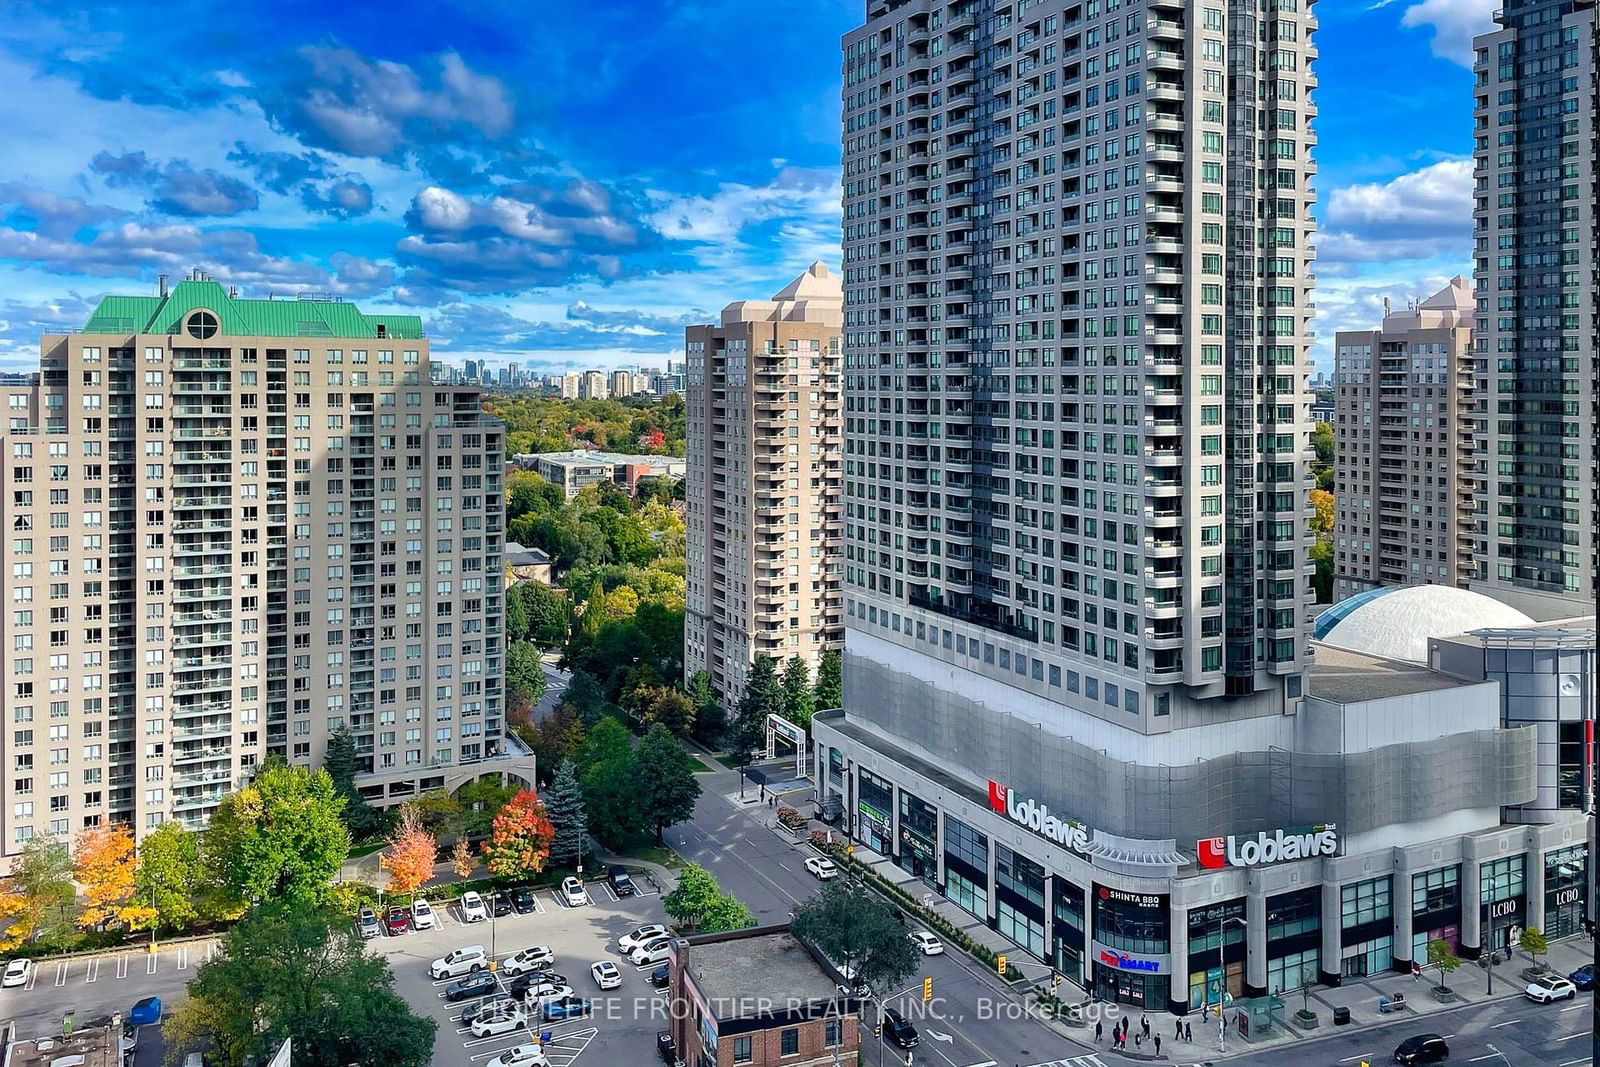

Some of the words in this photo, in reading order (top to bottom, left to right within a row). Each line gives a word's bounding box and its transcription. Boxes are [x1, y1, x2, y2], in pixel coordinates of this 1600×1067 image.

[1007, 788, 1088, 853] Loblaws
[1226, 829, 1337, 867] Loblaws
[1110, 890, 1141, 903] SHINTA
[1142, 896, 1160, 904] BBQ
[1556, 888, 1579, 906] LCBO
[1492, 899, 1516, 918] LCBO
